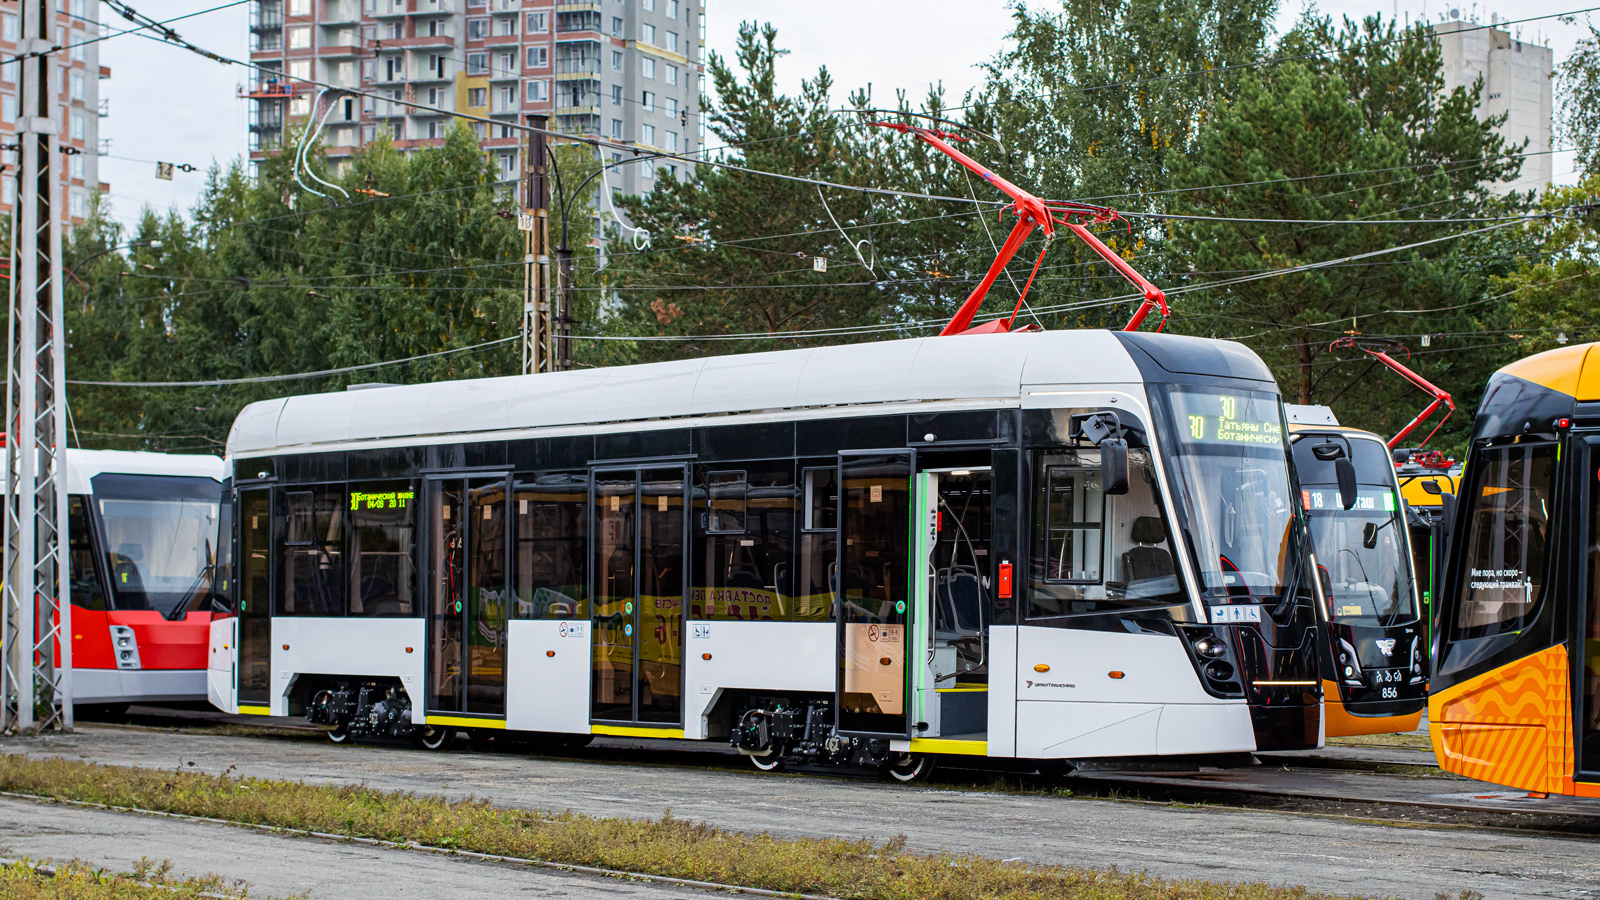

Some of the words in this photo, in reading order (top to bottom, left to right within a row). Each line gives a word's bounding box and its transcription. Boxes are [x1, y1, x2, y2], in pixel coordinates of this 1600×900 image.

[815, 260, 825, 269] 12
[1220, 396, 1234, 419] 30
[1189, 415, 1203, 439] 30
[1219, 417, 1258, 432] Татьяны
[1263, 422, 1280, 433] Сне
[1312, 492, 1323, 508] 18
[1471, 568, 1482, 577] Мне
[1496, 569, 1503, 577] но
[1503, 569, 1518, 578] скоро
[1471, 579, 1499, 590] следующий
[1382, 686, 1397, 698] 856
